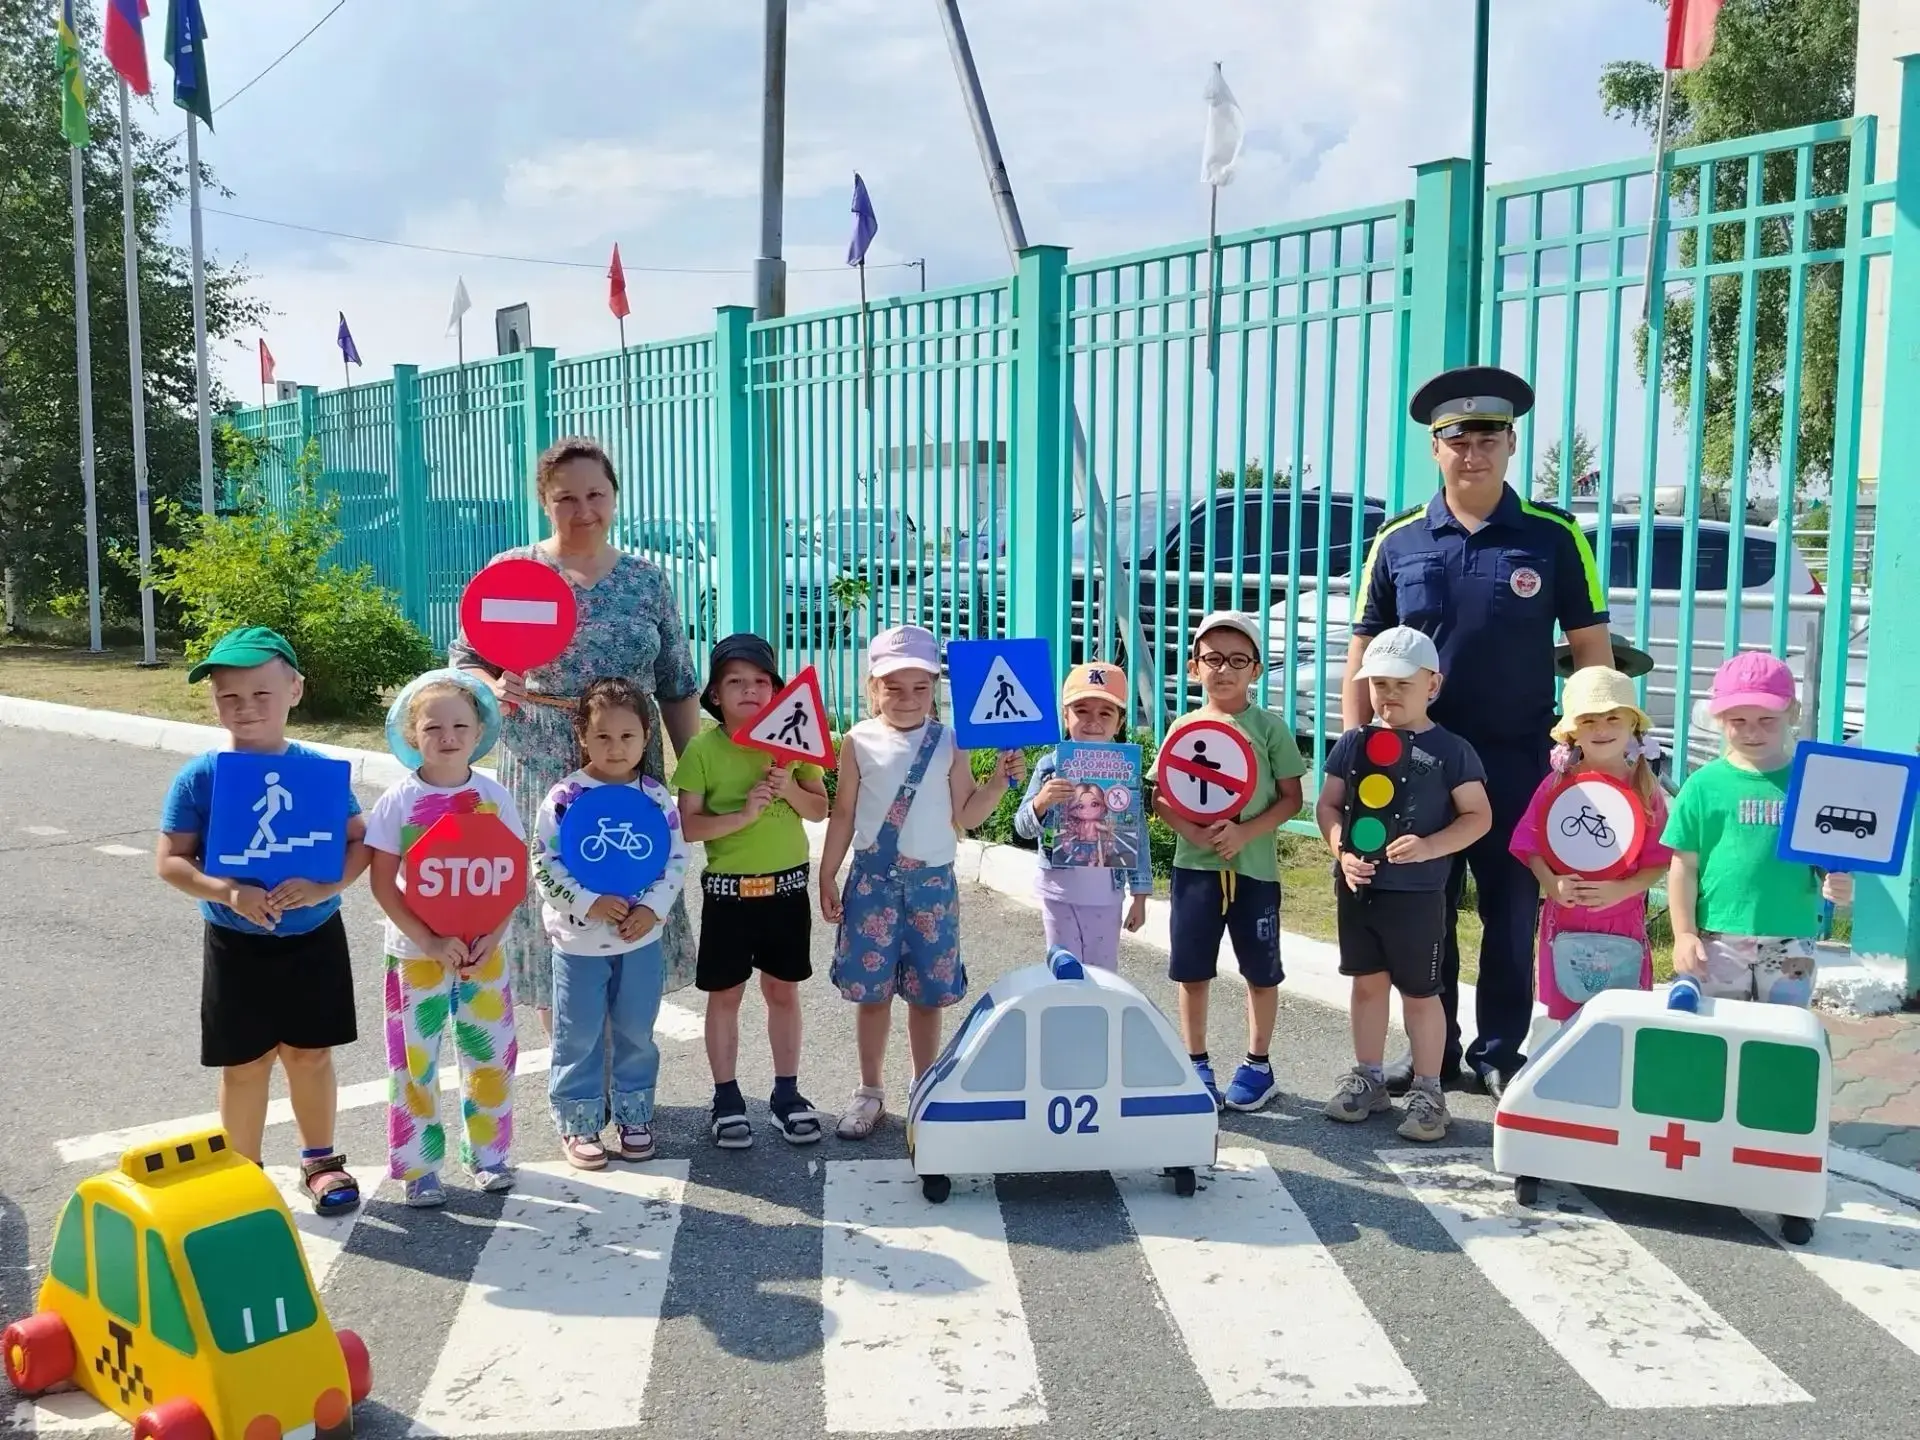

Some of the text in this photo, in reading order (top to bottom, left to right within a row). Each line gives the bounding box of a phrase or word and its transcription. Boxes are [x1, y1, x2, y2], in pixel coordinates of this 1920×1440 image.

[1088, 669, 1106, 685] K
[1074, 749, 1124, 760] ПРАВИЛА
[1062, 759, 1135, 771] ДОРОЖНОГО
[1067, 769, 1131, 780] ДВИЖЕНИЯ
[418, 857, 515, 897] STOP
[1048, 1095, 1099, 1134] 02
